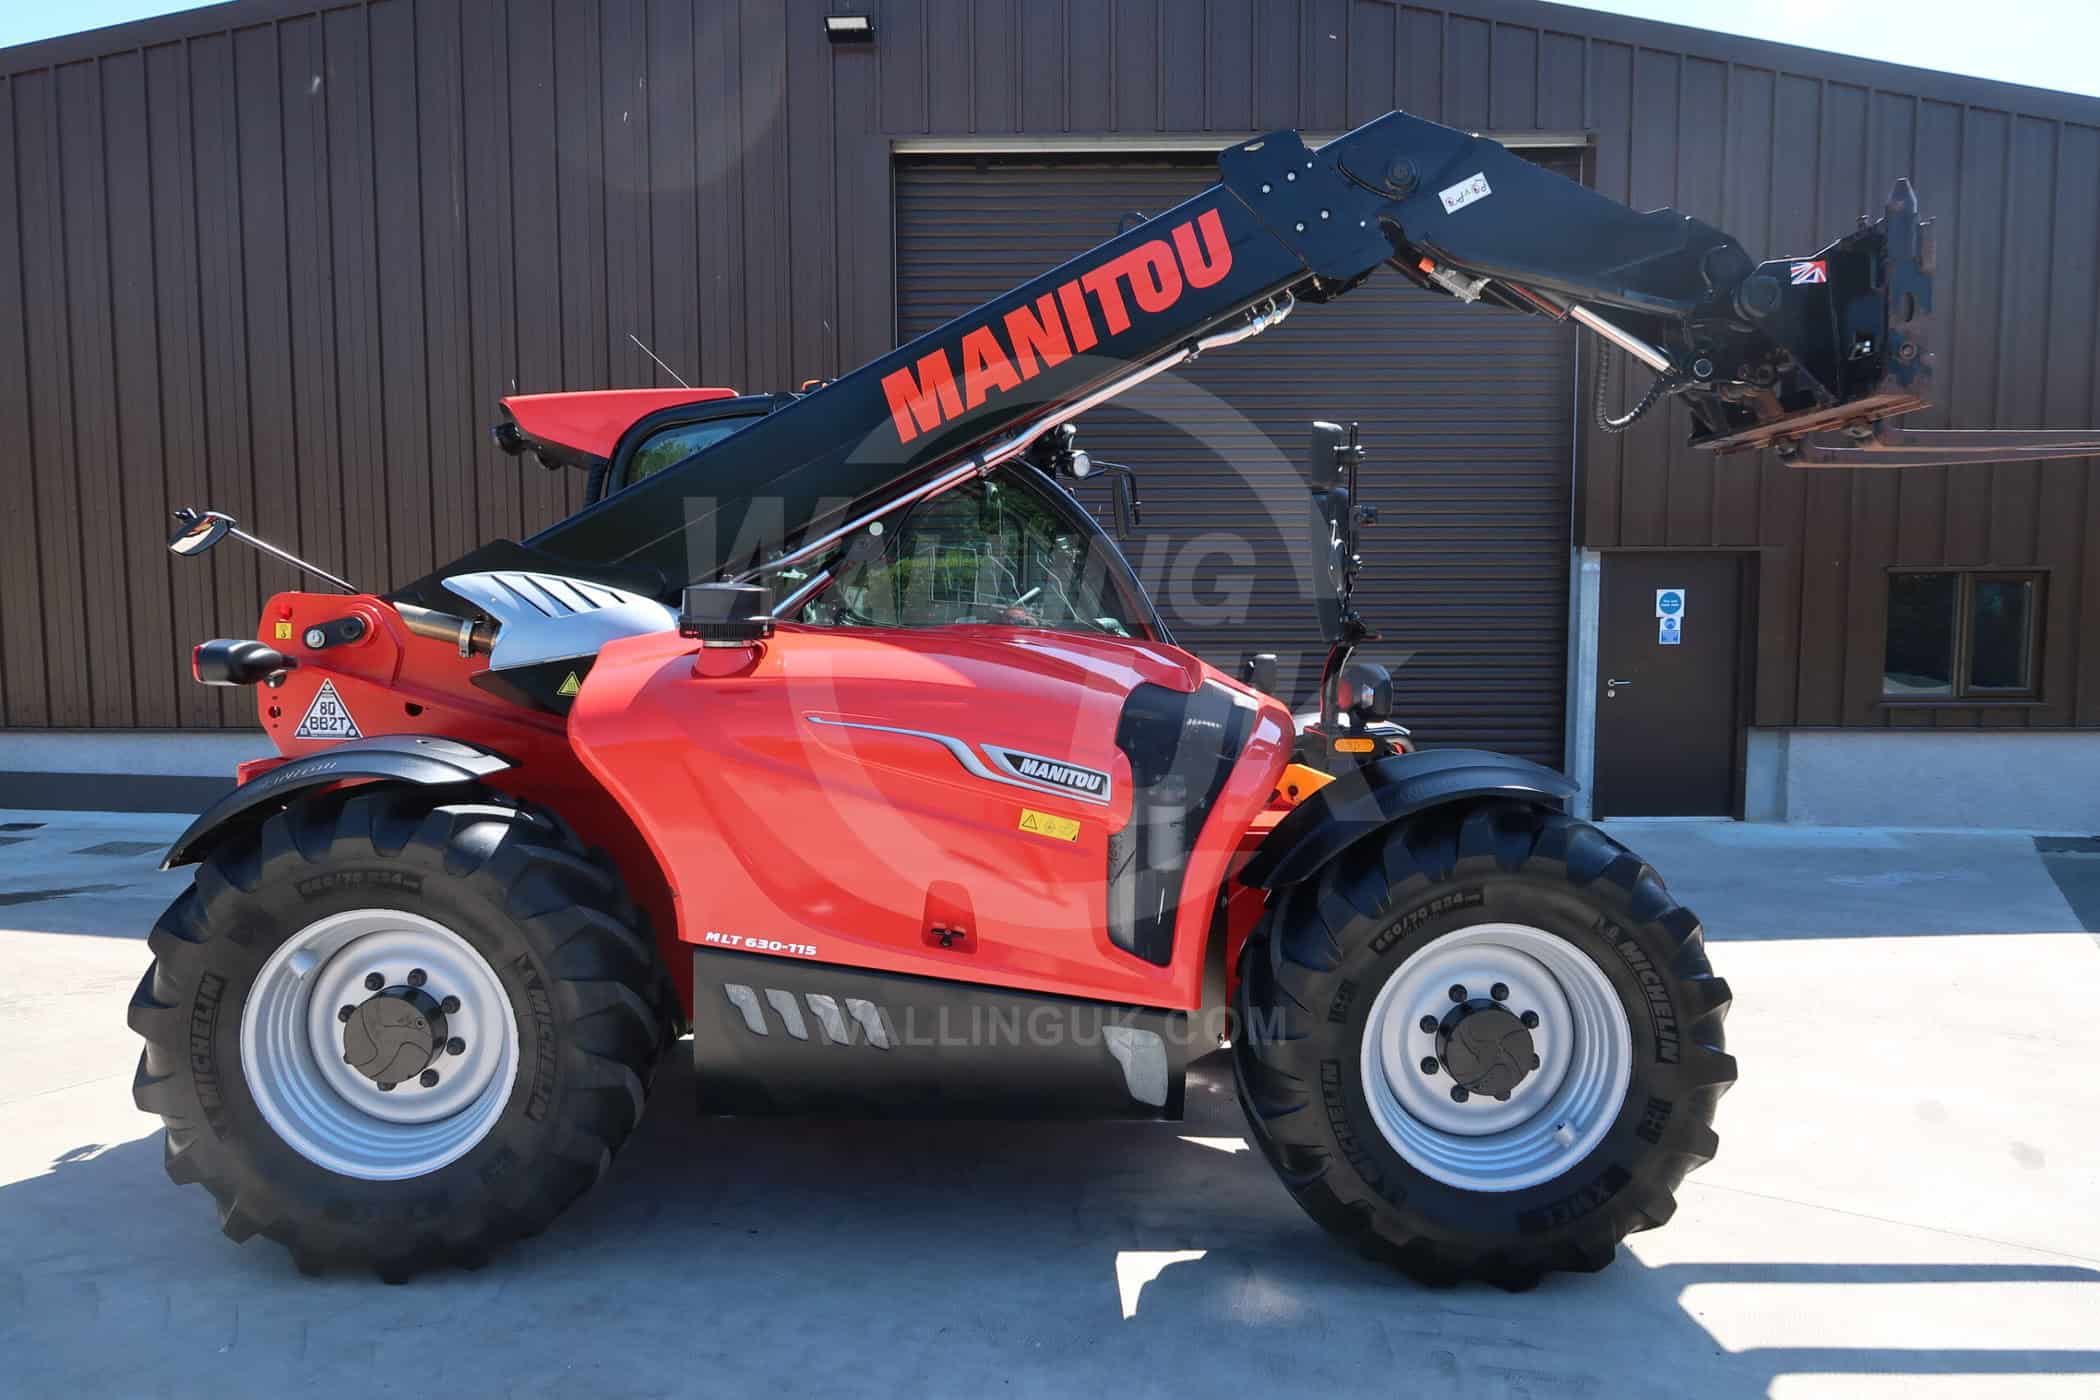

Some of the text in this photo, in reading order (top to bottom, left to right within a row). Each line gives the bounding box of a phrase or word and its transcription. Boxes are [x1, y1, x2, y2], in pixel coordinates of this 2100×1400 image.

[880, 208, 1233, 445] MANITOU
[1020, 758, 1102, 790] MANITOU
[704, 931, 817, 957] MLT 630-115
[1616, 938, 1680, 1065] MICHELIN
[191, 972, 226, 1112] MICHELIN
